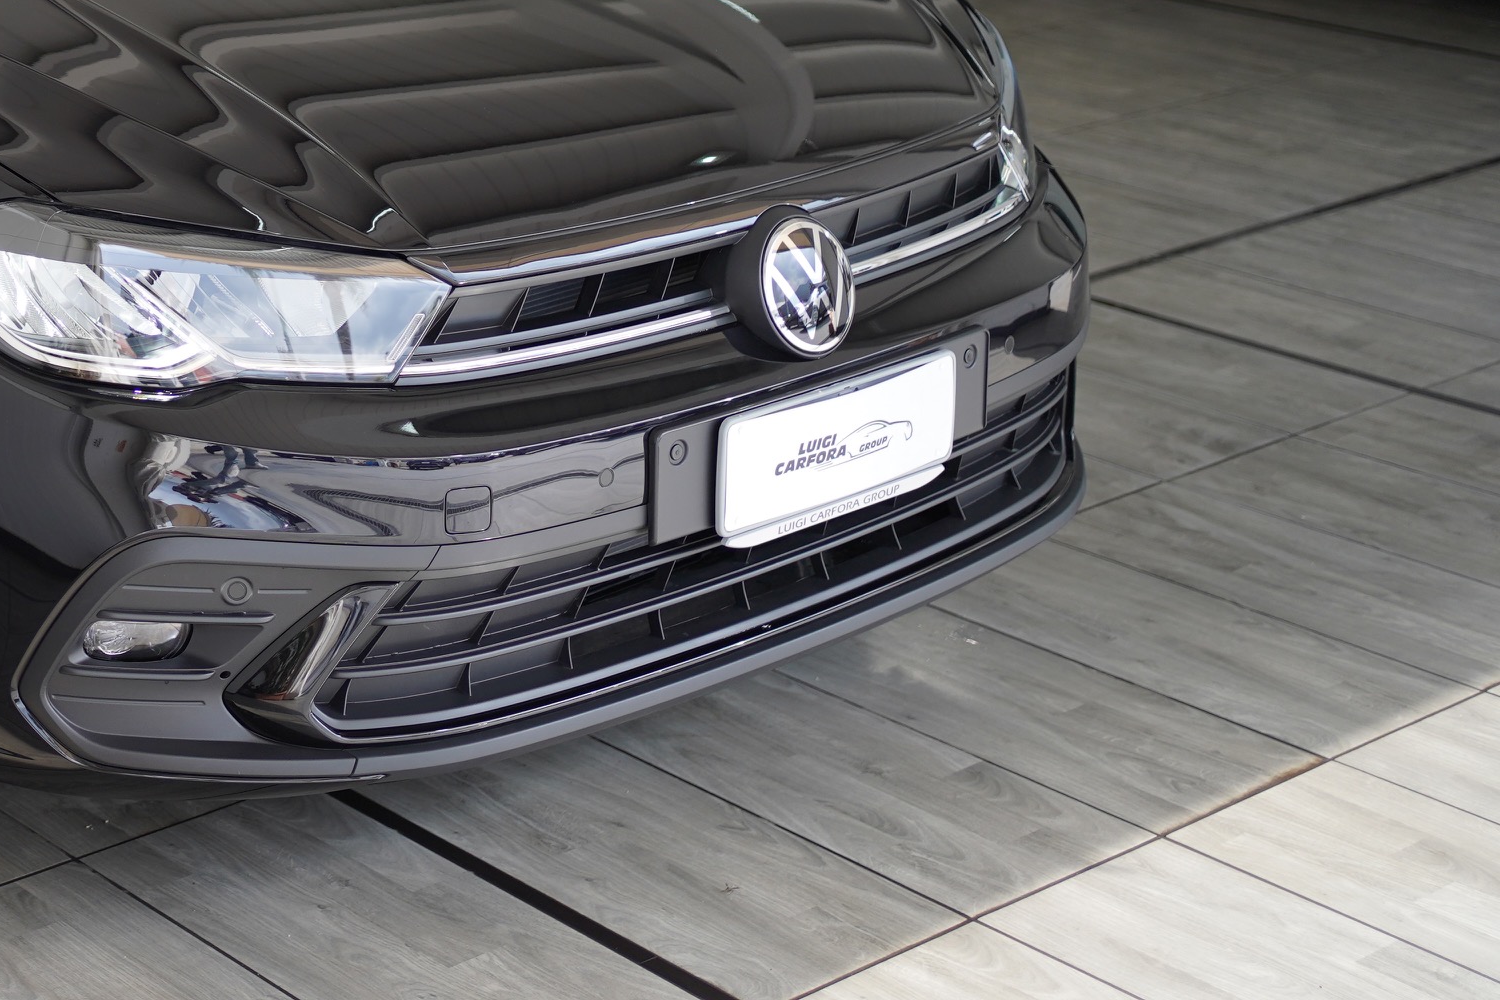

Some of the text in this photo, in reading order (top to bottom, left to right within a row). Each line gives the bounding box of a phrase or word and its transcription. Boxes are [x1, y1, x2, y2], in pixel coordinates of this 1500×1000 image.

[774, 437, 888, 476] CARFORA GROUP
[798, 433, 837, 455] LUIGI
[778, 484, 900, 535] LUIGI CARFORA GROUP
